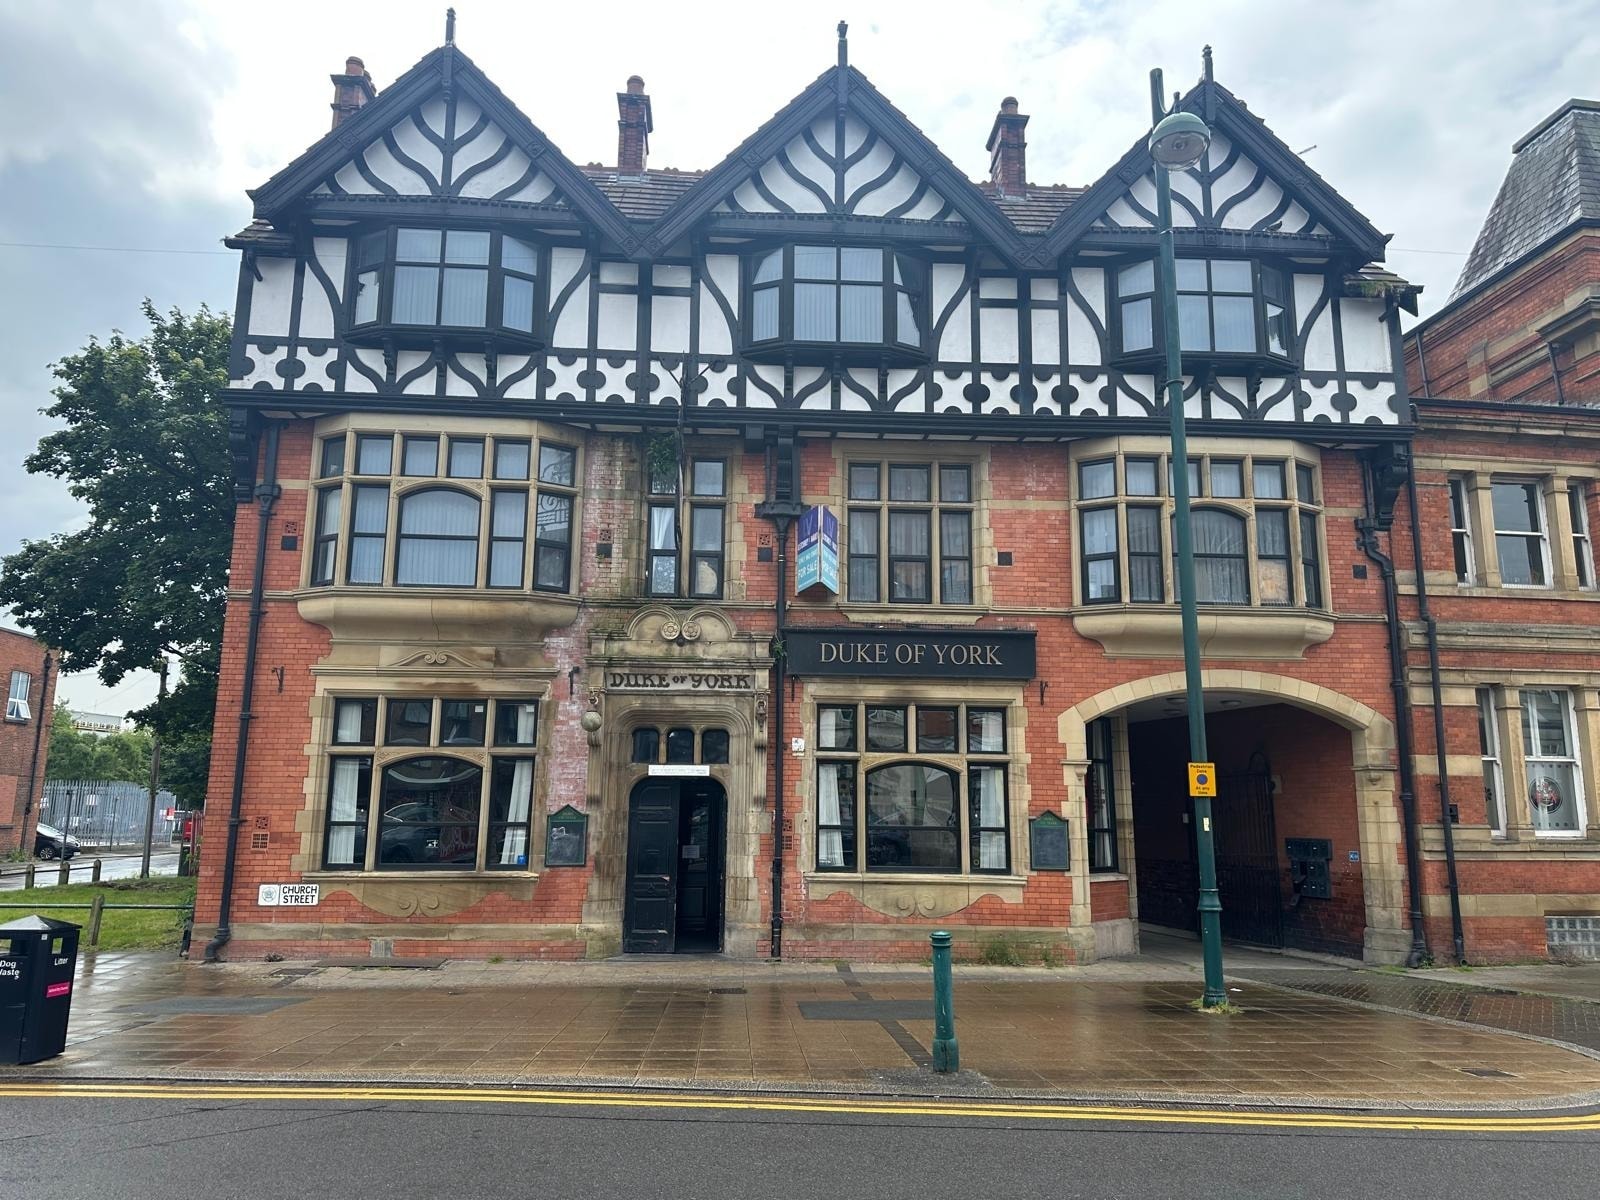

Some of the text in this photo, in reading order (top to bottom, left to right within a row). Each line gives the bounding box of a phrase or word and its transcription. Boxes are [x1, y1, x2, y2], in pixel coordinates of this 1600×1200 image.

[818, 642, 1004, 665] DUKE OF YORK
[609, 672, 751, 689] DUKE OF YORK
[282, 885, 318, 895] CHURCH
[282, 895, 316, 904] STREET
[0, 959, 17, 969] Dog
